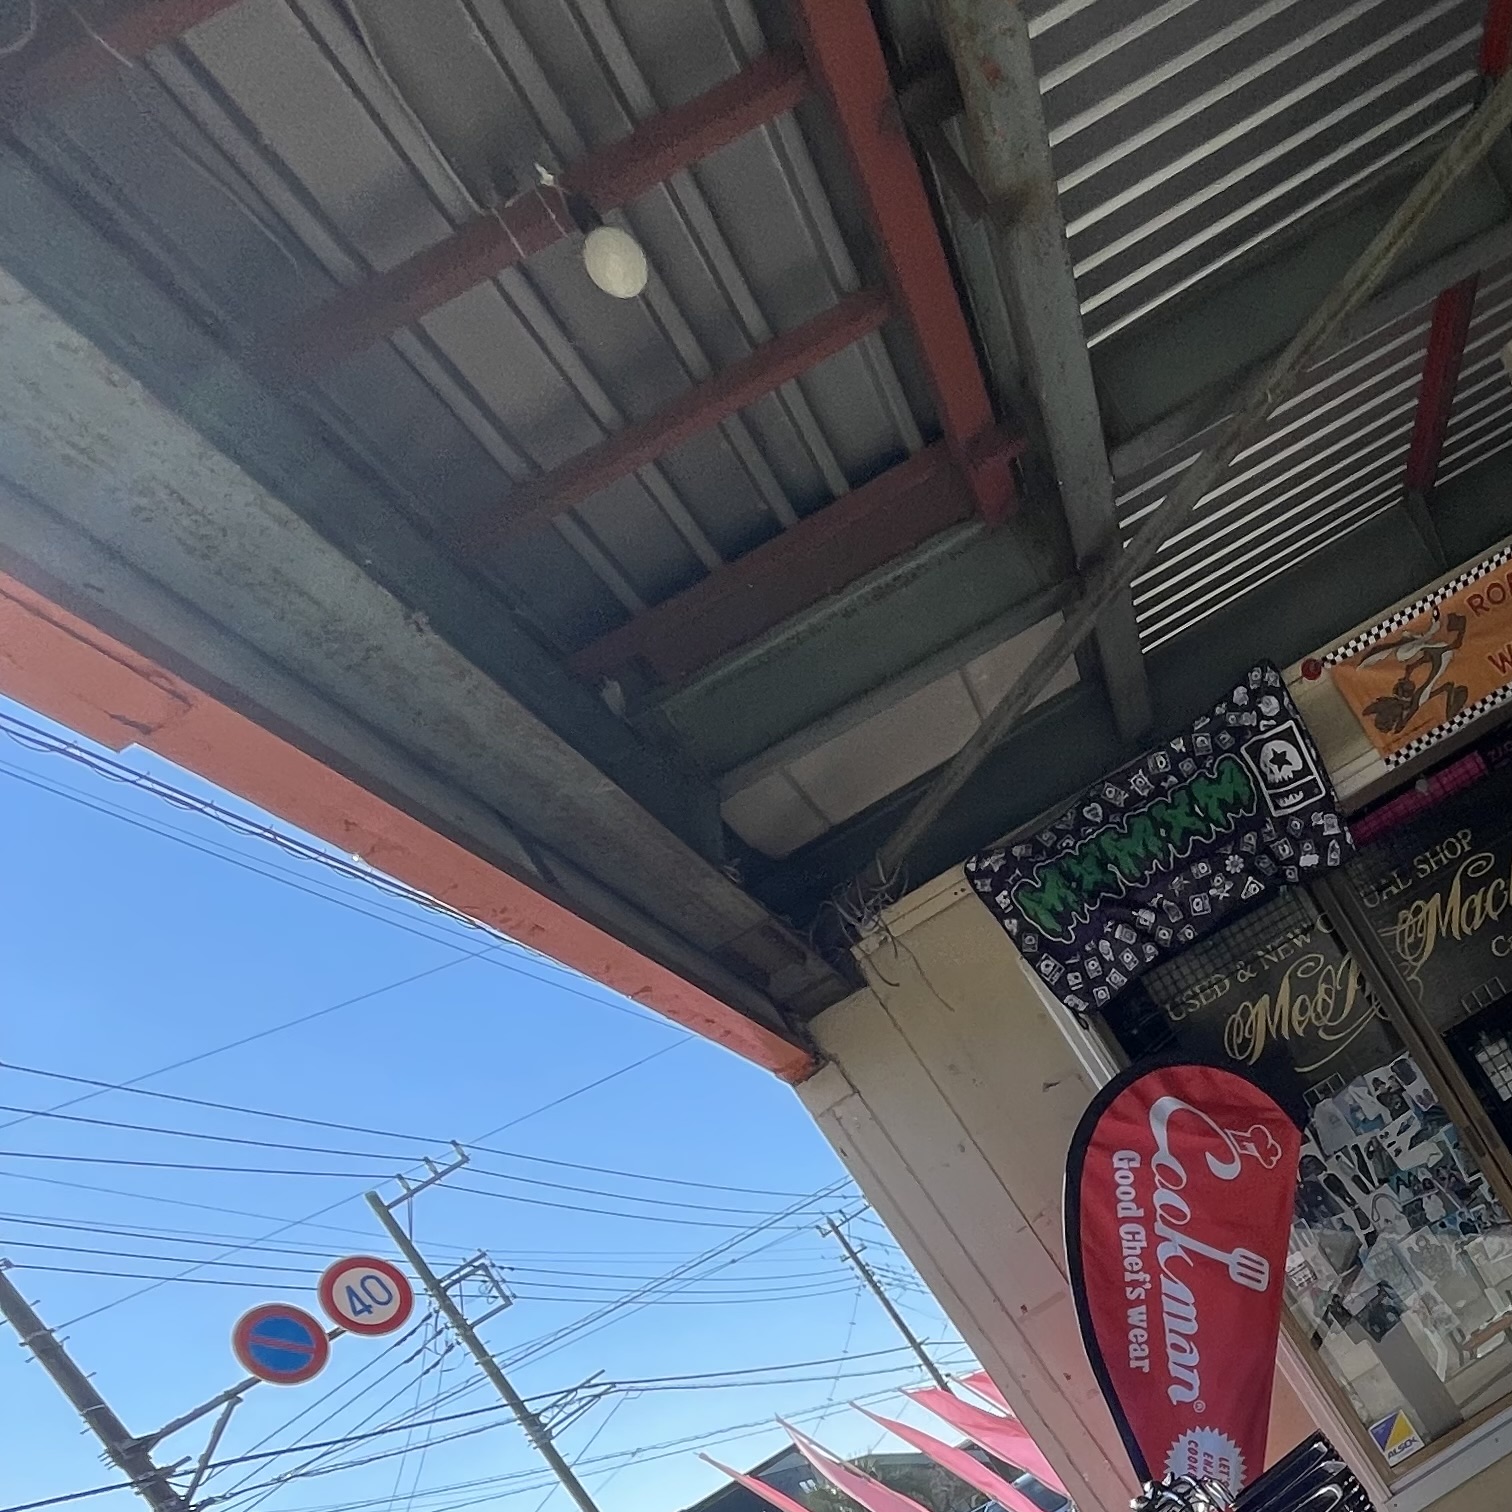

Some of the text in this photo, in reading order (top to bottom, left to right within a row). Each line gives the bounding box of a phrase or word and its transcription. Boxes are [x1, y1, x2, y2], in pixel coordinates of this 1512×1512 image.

[1413, 826, 1475, 880] SHOP
[1165, 974, 1233, 1022] USED
[1233, 960, 1257, 985] &
[1257, 925, 1316, 973] NEW
[1112, 1149, 1153, 1373] Good Chef's wear
[344, 1274, 394, 1317] 40
[1386, 1434, 1420, 1460] ALSOK
